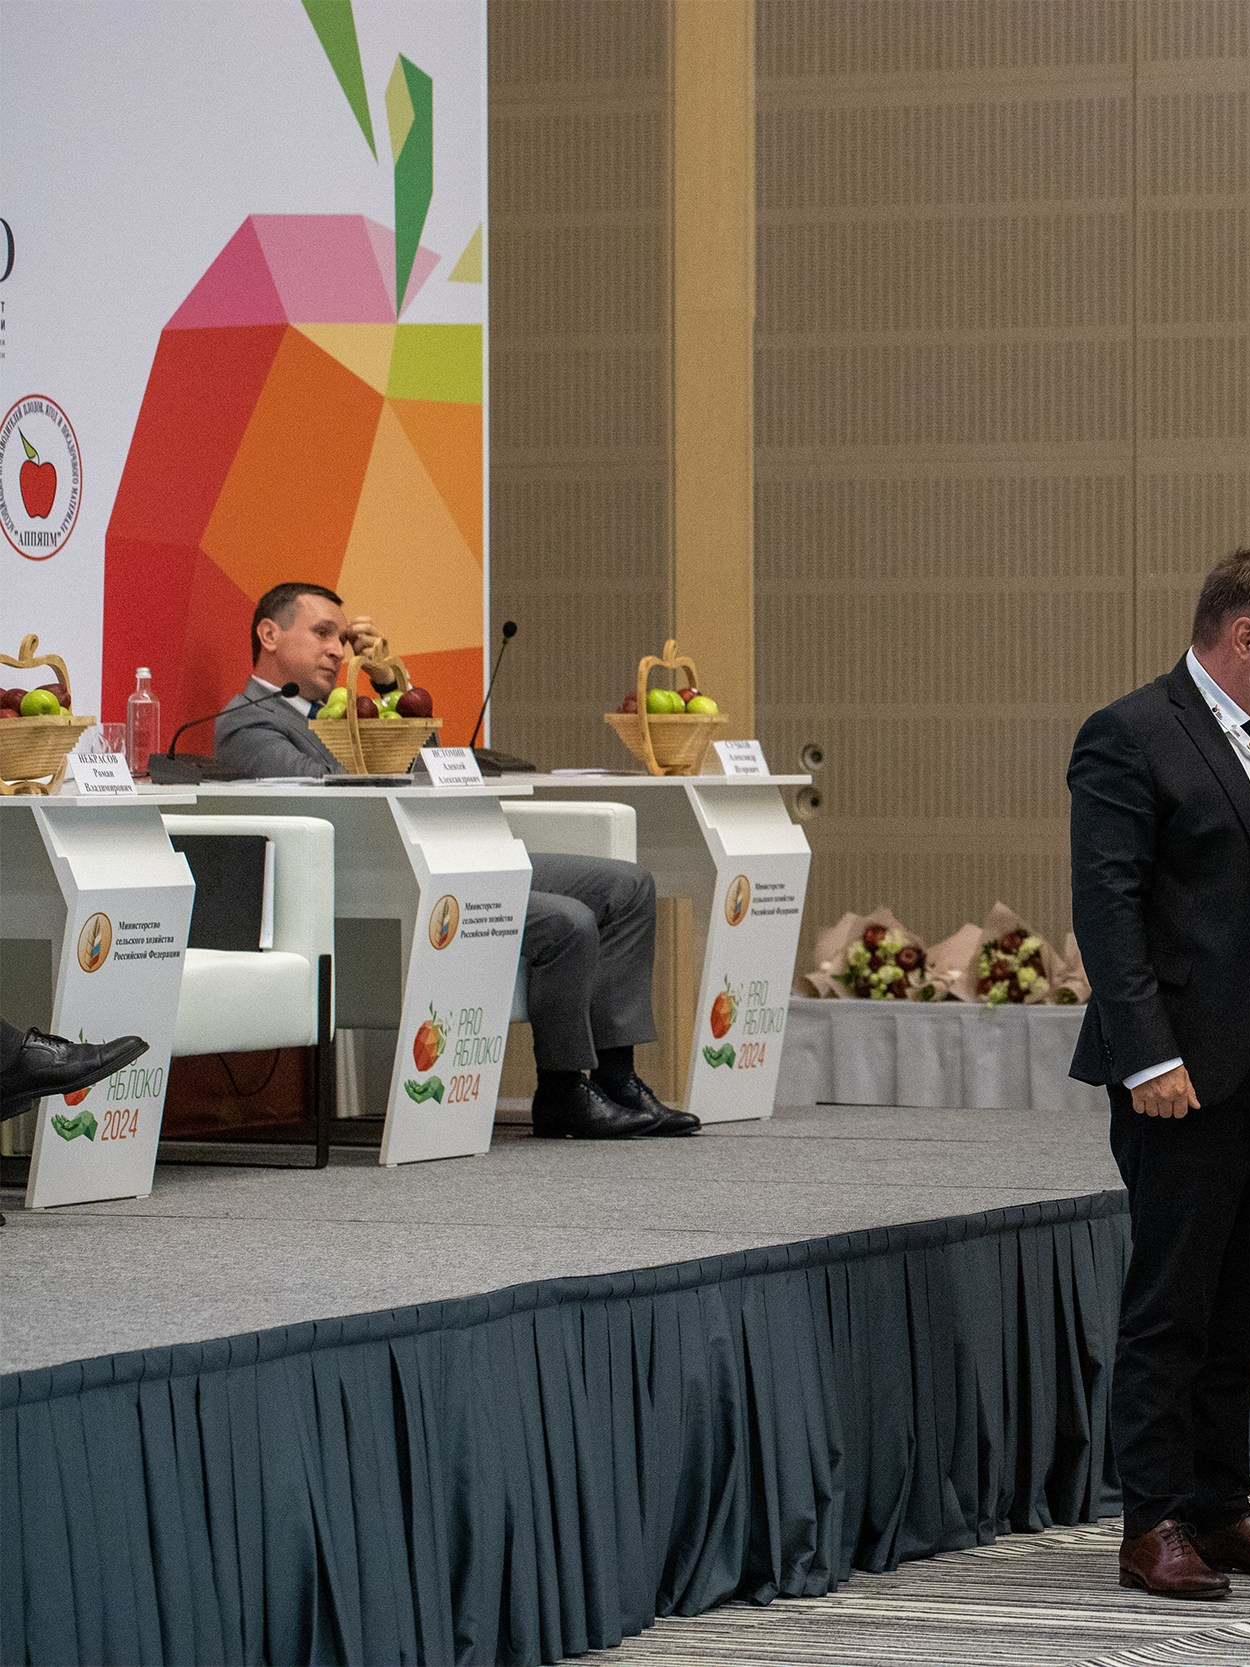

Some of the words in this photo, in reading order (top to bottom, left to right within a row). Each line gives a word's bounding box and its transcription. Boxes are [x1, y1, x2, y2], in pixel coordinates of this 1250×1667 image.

[14, 530, 61, 547] "АППЯПМ"
[78, 753, 119, 764] НЕКРАСОВ
[93, 768, 115, 778] Роман
[84, 782, 133, 795] Владимирович
[465, 902, 501, 911] Министерство
[118, 921, 161, 931] Министерство
[462, 916, 488, 925] сельского
[488, 914, 514, 923] хозяйства
[460, 929, 490, 938] Российской
[490, 928, 519, 938] Федерации
[115, 937, 145, 946] сельского
[145, 935, 174, 944] хозяйства
[113, 951, 147, 961] Российской
[148, 950, 181, 960] Федерации
[747, 980, 769, 1008] PRO
[457, 1007, 483, 1036] PRO
[452, 1035, 503, 1067] ЯБЛОКО
[738, 1042, 766, 1070] 2024
[106, 1067, 163, 1101] ЯБЛОКО
[447, 1073, 481, 1104] 2024
[101, 1108, 139, 1141] 2024
